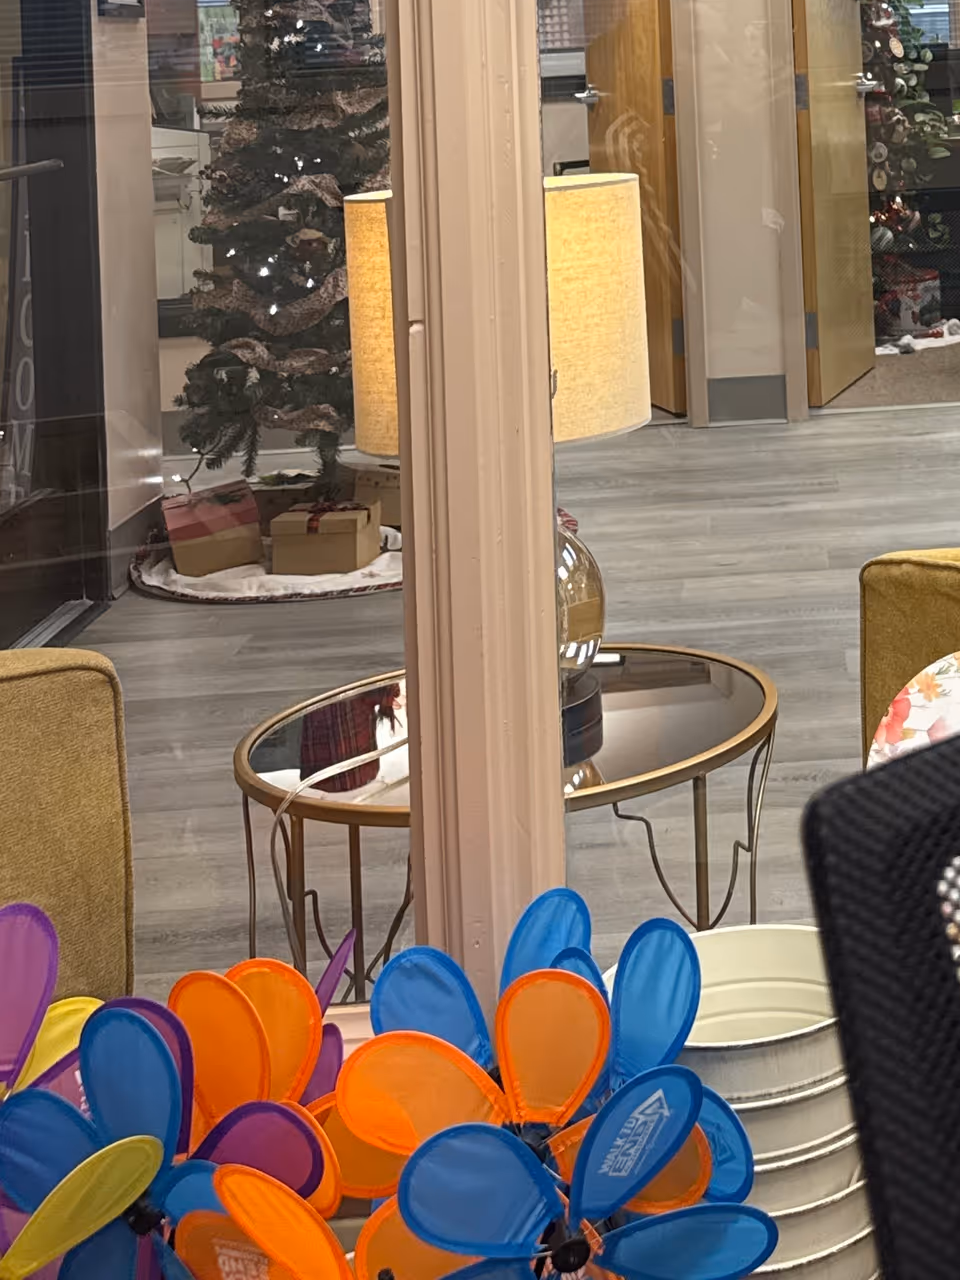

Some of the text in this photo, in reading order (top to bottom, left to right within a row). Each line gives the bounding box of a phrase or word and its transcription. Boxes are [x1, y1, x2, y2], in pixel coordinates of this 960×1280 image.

[597, 1117, 638, 1174] WALK TO
[611, 1120, 648, 1173] END
